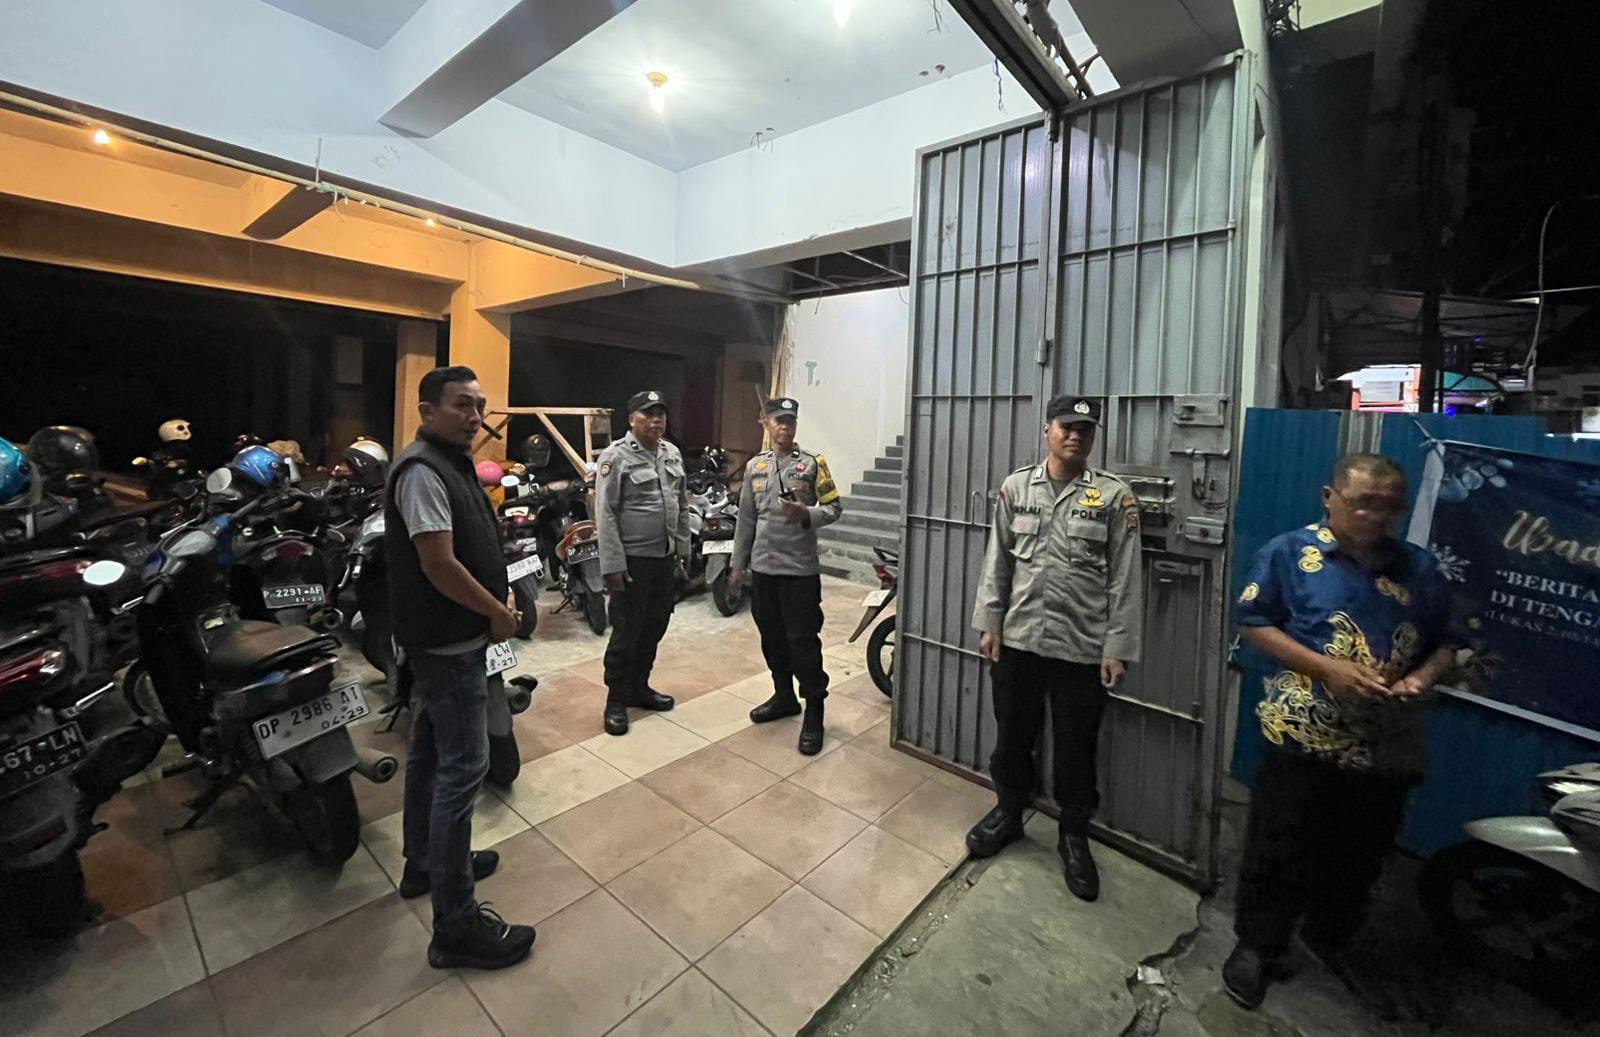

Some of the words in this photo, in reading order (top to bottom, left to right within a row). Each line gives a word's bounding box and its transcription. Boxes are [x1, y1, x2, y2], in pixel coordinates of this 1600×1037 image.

[1490, 590, 1516, 608] DI
[258, 718, 280, 740] DP
[290, 697, 333, 726] 2986
[0, 744, 32, 774] 67
